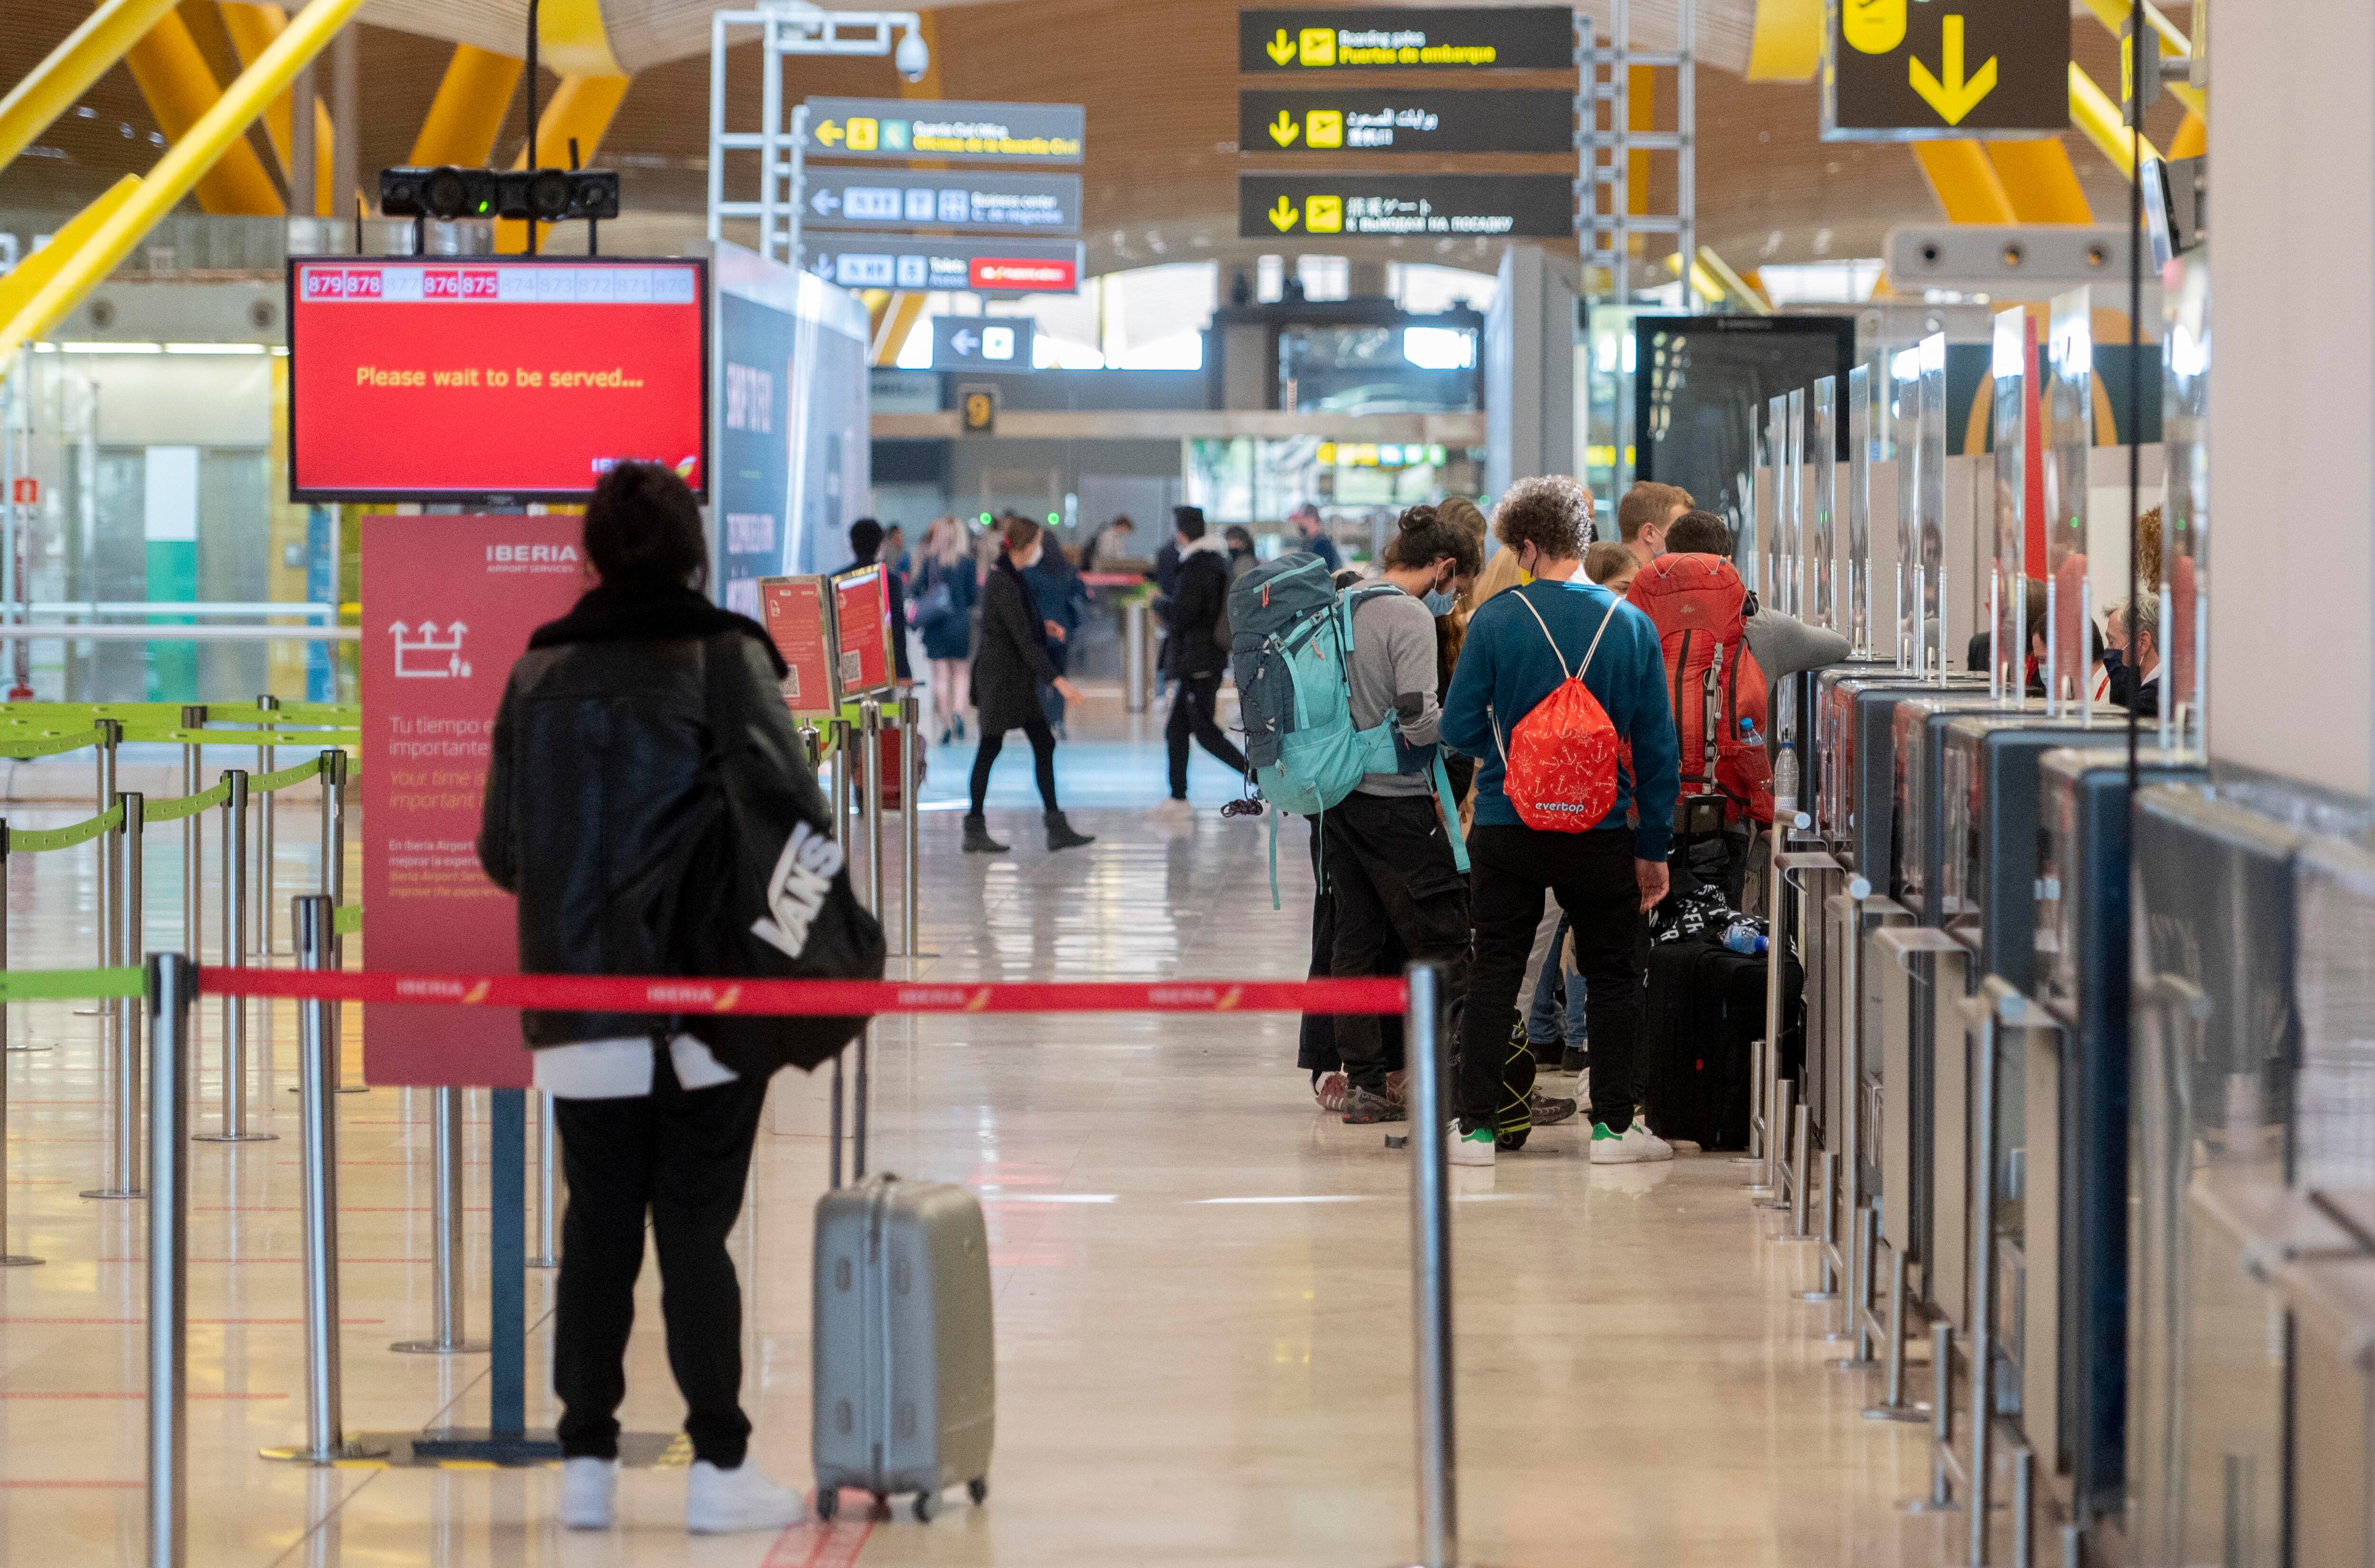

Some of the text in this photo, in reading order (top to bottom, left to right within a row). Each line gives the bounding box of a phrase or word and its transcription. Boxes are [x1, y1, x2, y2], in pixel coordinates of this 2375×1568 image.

[308, 276, 342, 293] 879
[347, 276, 381, 293] 878
[386, 277, 418, 293] 877
[424, 276, 458, 293] 876
[463, 276, 496, 293] 875
[357, 367, 643, 387] Please wait to be served...
[486, 545, 578, 562] IBERIA
[390, 717, 495, 737] Tu tiempo e
[390, 738, 489, 759] importante
[390, 770, 427, 785] Your
[432, 769, 470, 785] time
[390, 792, 475, 811] important
[1535, 801, 1585, 814] evertop
[405, 840, 434, 850] Iberia
[750, 821, 844, 959] VANS
[396, 978, 463, 996] IBERIA
[647, 985, 714, 1004] IBERIA
[1148, 987, 1216, 1005] IBERIA
[897, 988, 964, 1005] IBERIA
